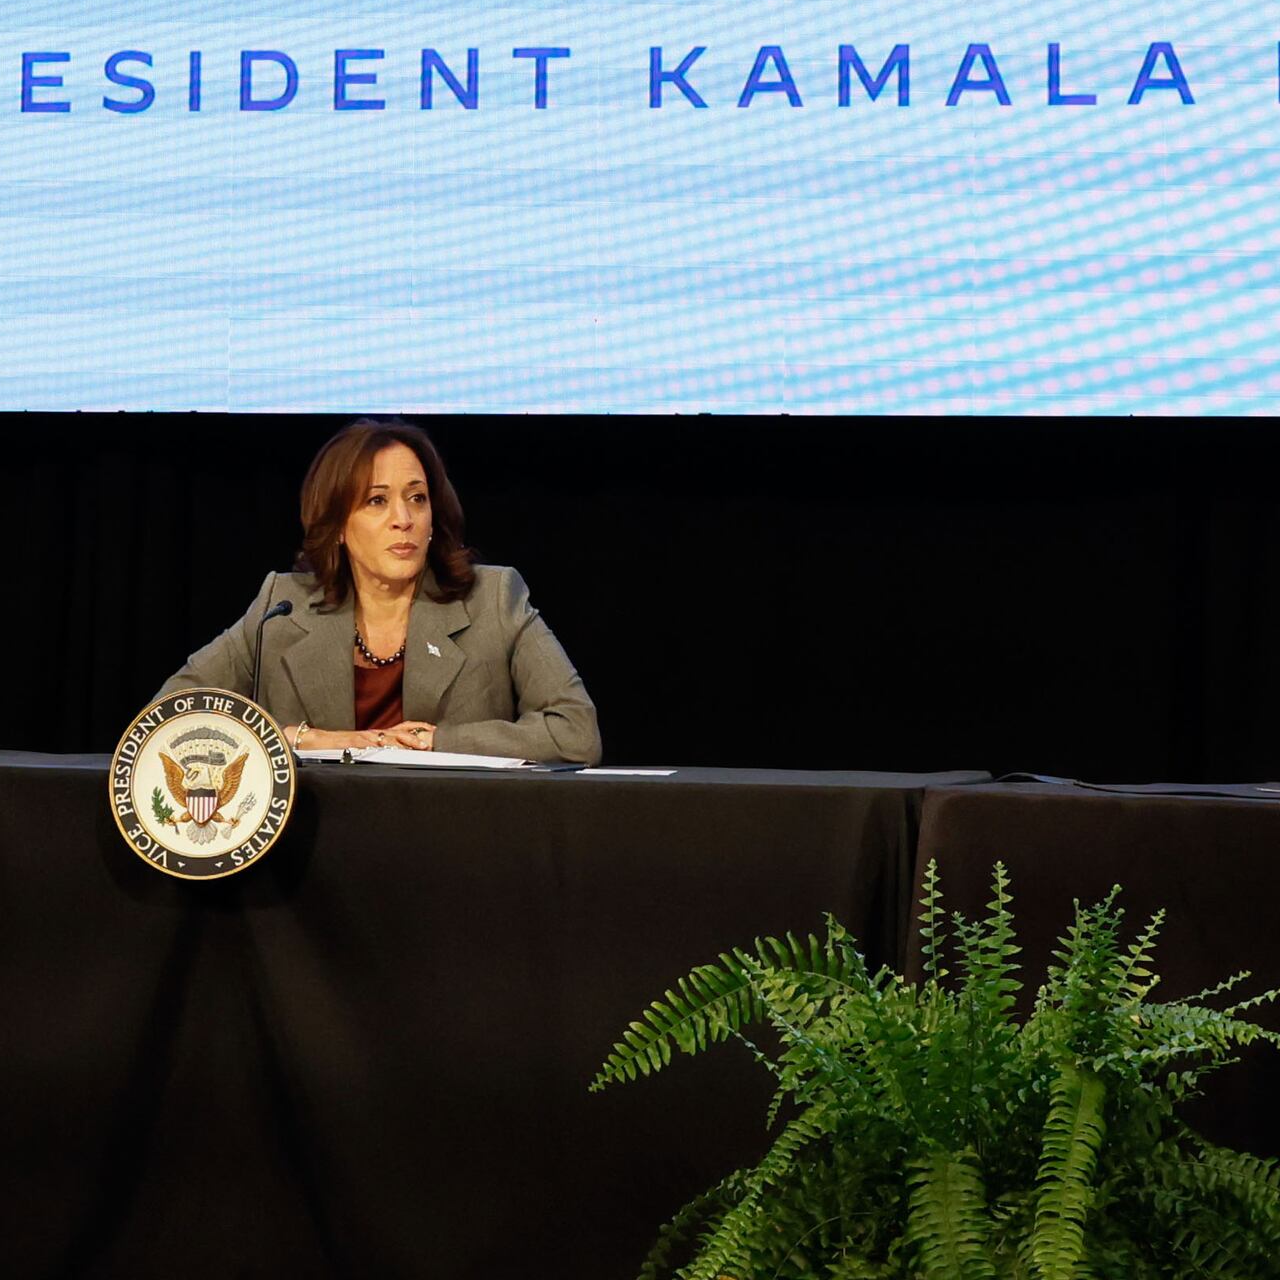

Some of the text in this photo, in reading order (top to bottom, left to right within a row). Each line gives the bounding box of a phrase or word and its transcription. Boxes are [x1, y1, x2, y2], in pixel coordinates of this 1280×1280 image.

[648, 41, 1197, 109] KAMALA
[174, 696, 195, 713] OF
[203, 696, 234, 713] THE
[114, 706, 164, 817] PRESIDENT
[242, 706, 290, 784] UNITED
[128, 823, 168, 868] VICE
[230, 797, 288, 866] STATES
